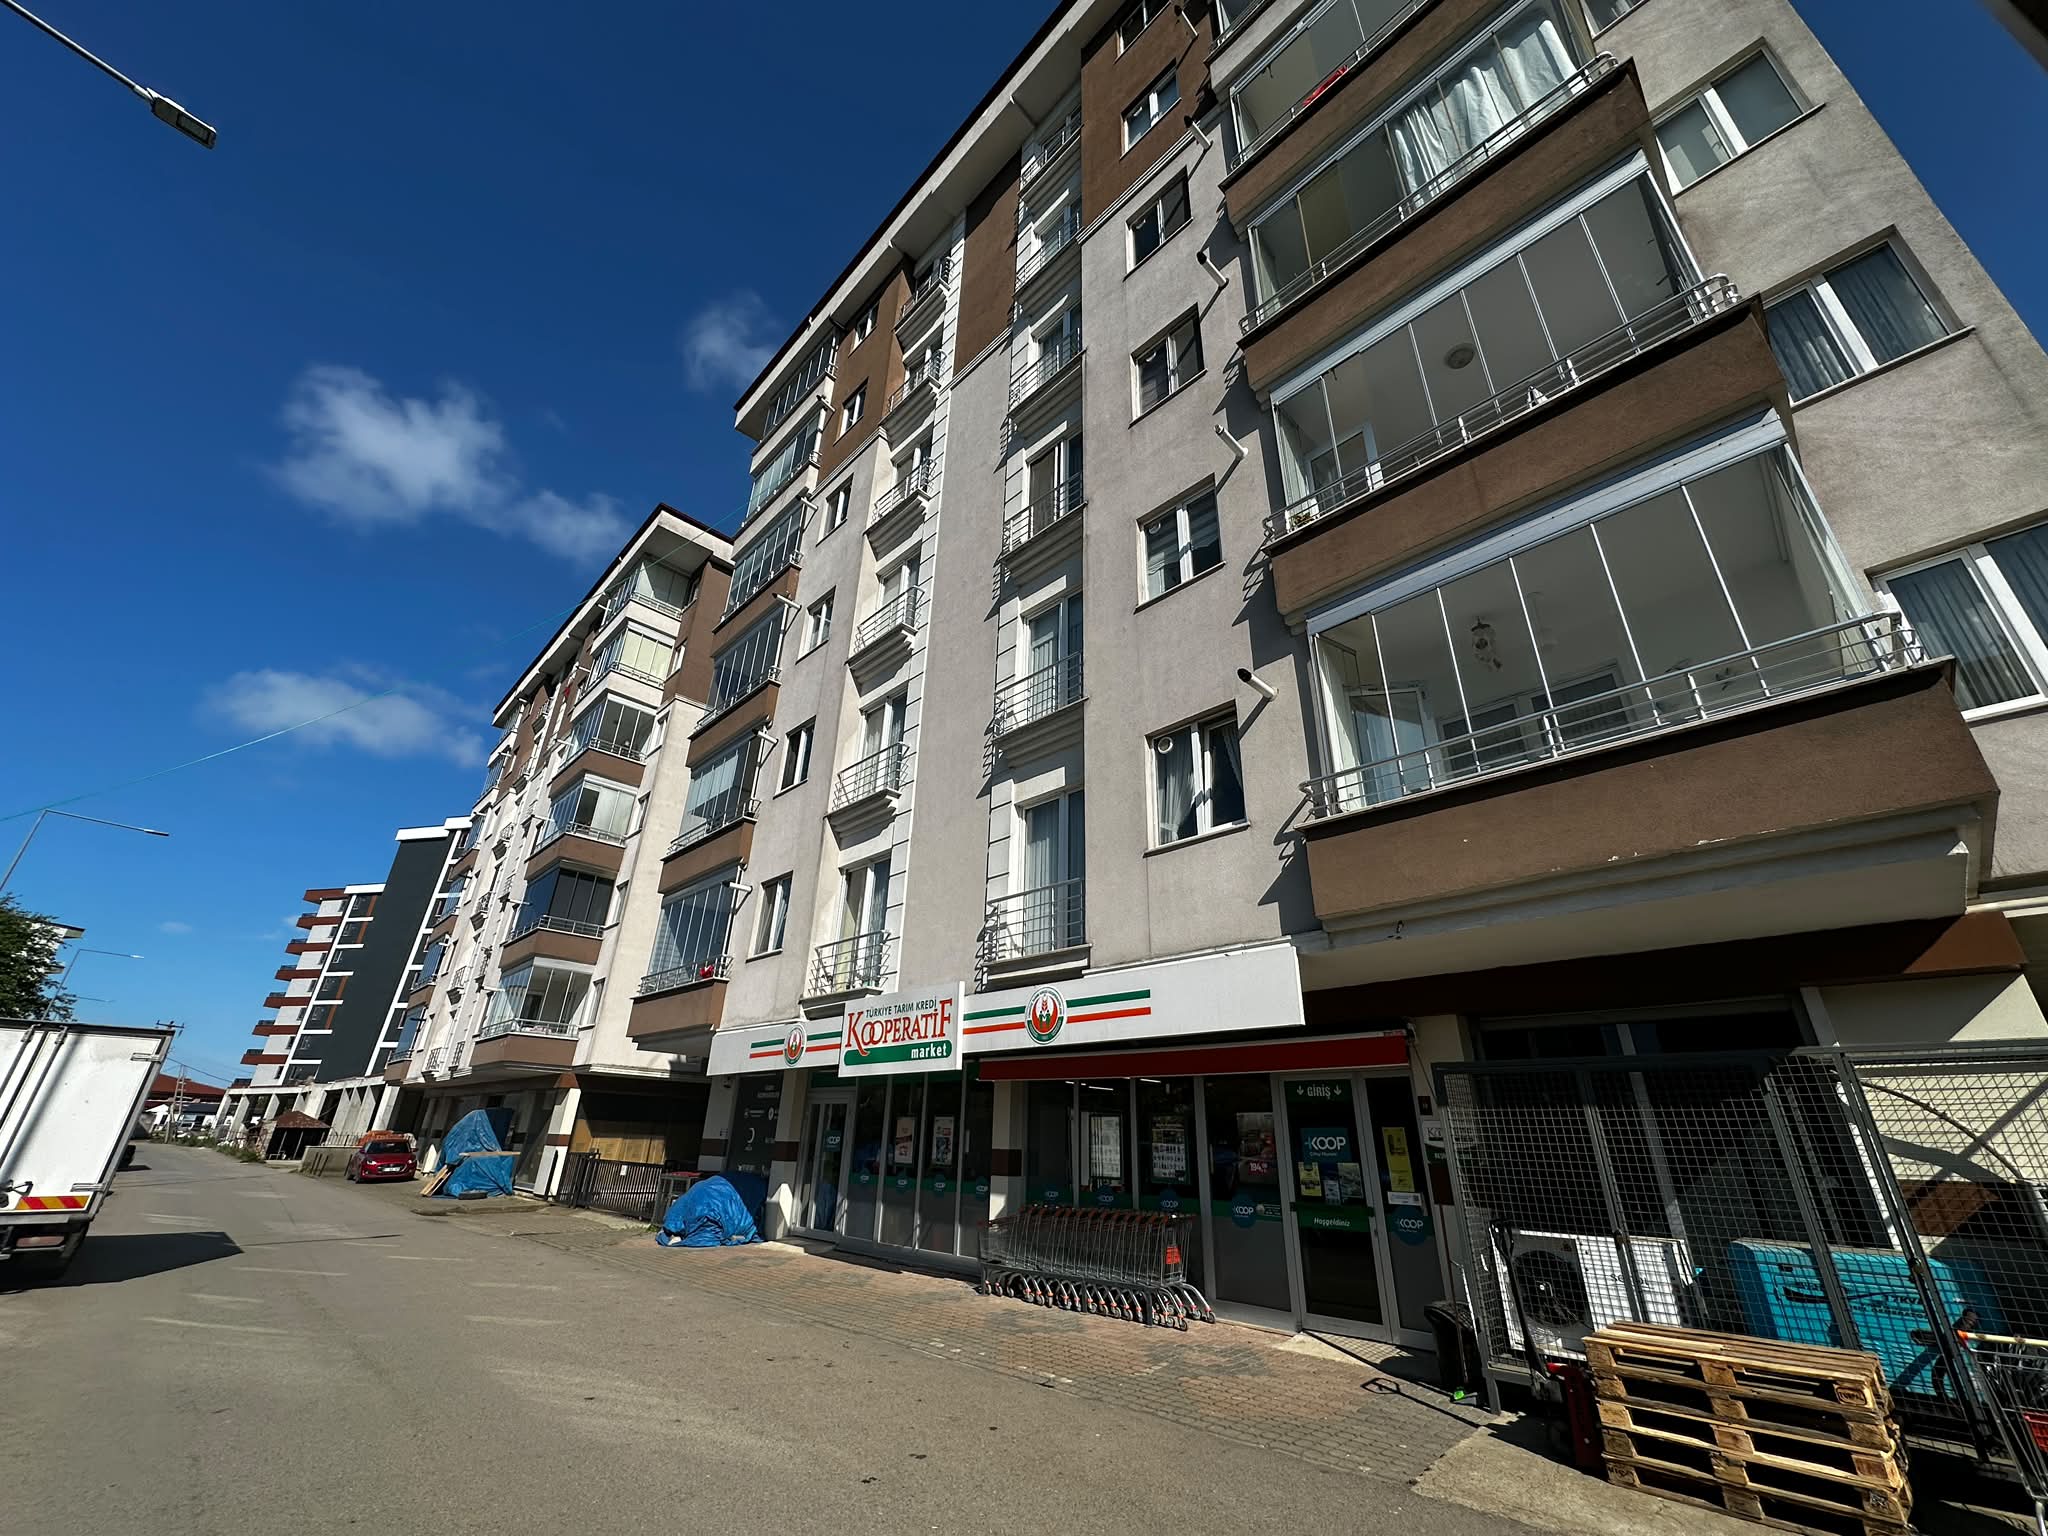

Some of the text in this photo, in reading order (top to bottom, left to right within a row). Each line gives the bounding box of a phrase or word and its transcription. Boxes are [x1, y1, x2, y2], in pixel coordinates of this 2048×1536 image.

[866, 996, 937, 1018] TÜRKİYE TARIM KREDİ
[845, 998, 953, 1057] KOOPERATİF
[911, 1043, 947, 1059] market
[1307, 1083, 1331, 1100] GİRİŞ
[1306, 1136, 1347, 1151] KOOP
[1398, 1218, 1424, 1229] KOOP
